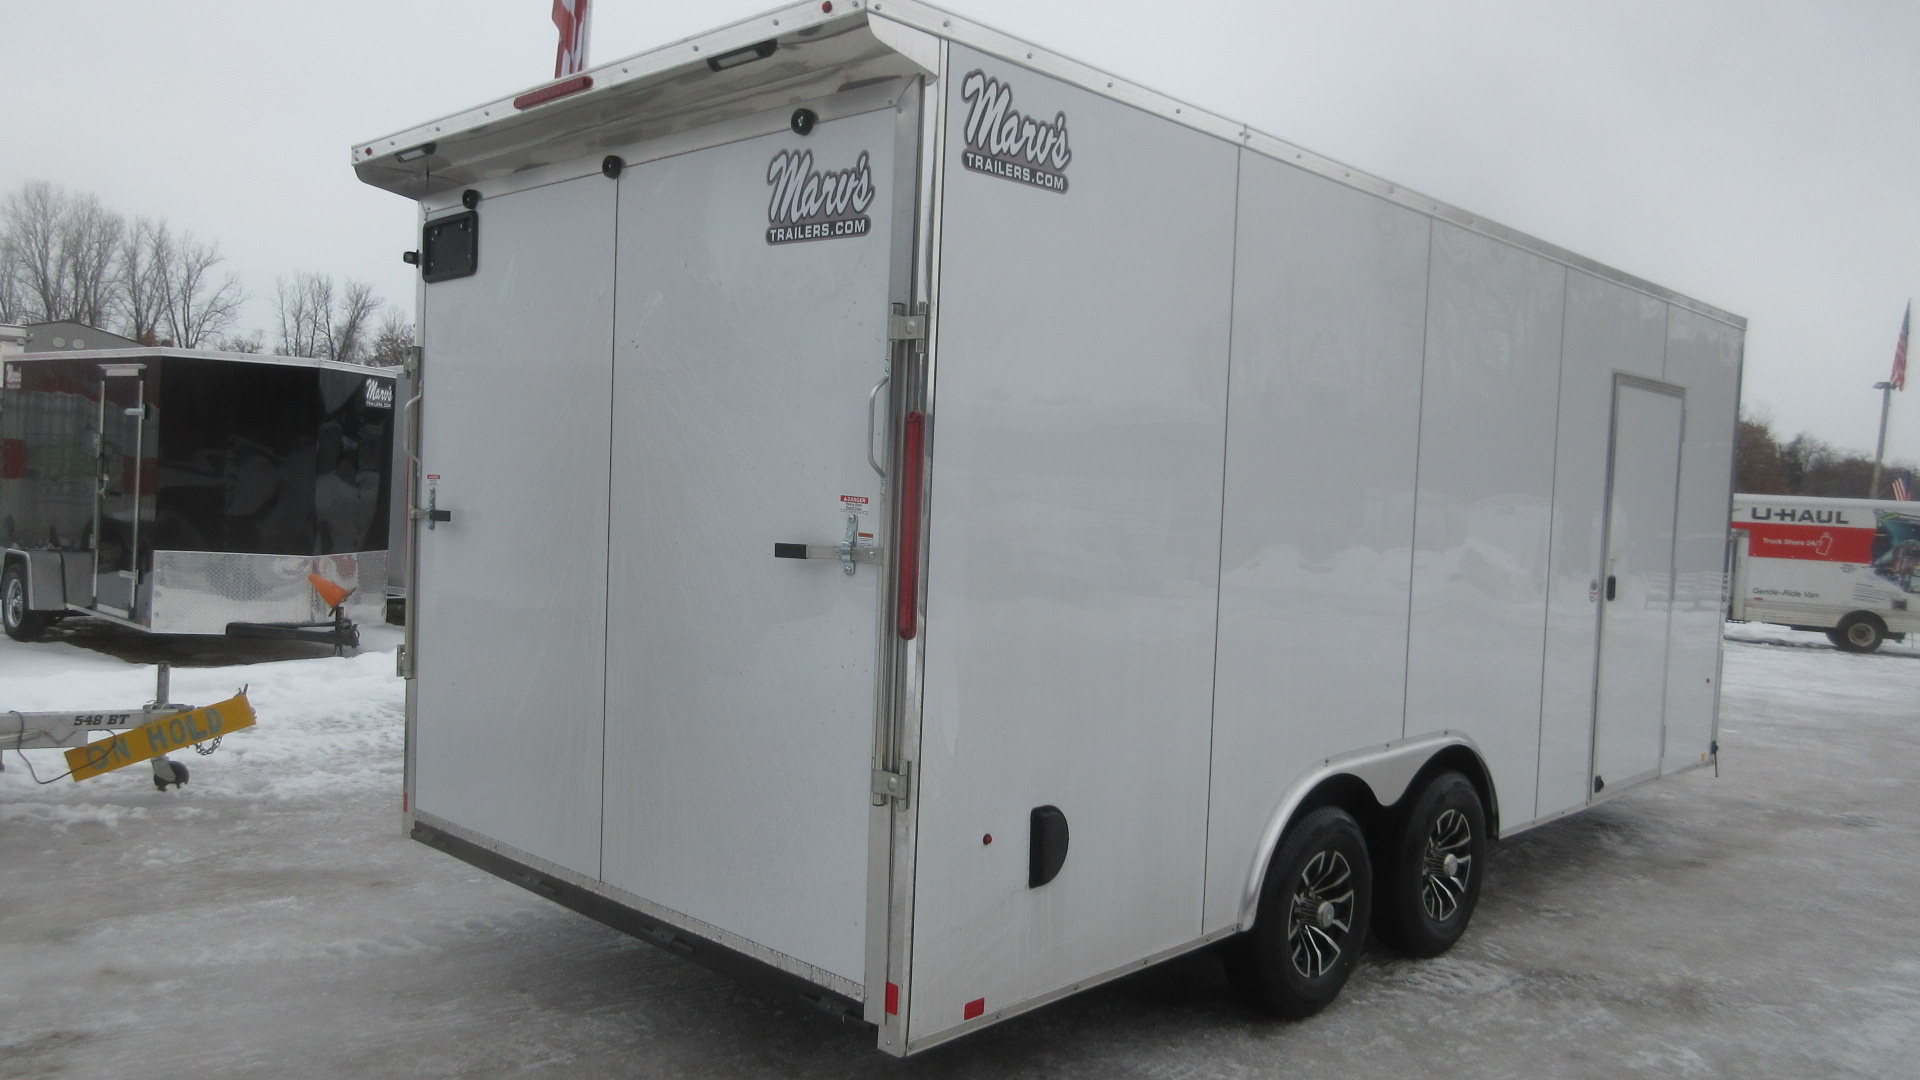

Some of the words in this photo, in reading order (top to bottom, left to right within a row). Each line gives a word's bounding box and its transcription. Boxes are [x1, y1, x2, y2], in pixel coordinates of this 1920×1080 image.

[965, 74, 1070, 168] Marv's
[966, 152, 1064, 190] TRAILERS.COM
[769, 151, 874, 223] Marv's
[770, 219, 865, 242] TRAILERS.COM
[1751, 507, 1849, 524] U-HAUL
[1763, 537, 1782, 545] Truck
[1752, 588, 1801, 597] Gentle-Ride
[74, 715, 103, 726] 548
[107, 714, 130, 725] BT
[87, 737, 132, 770] ON
[147, 707, 223, 752] HOLD
